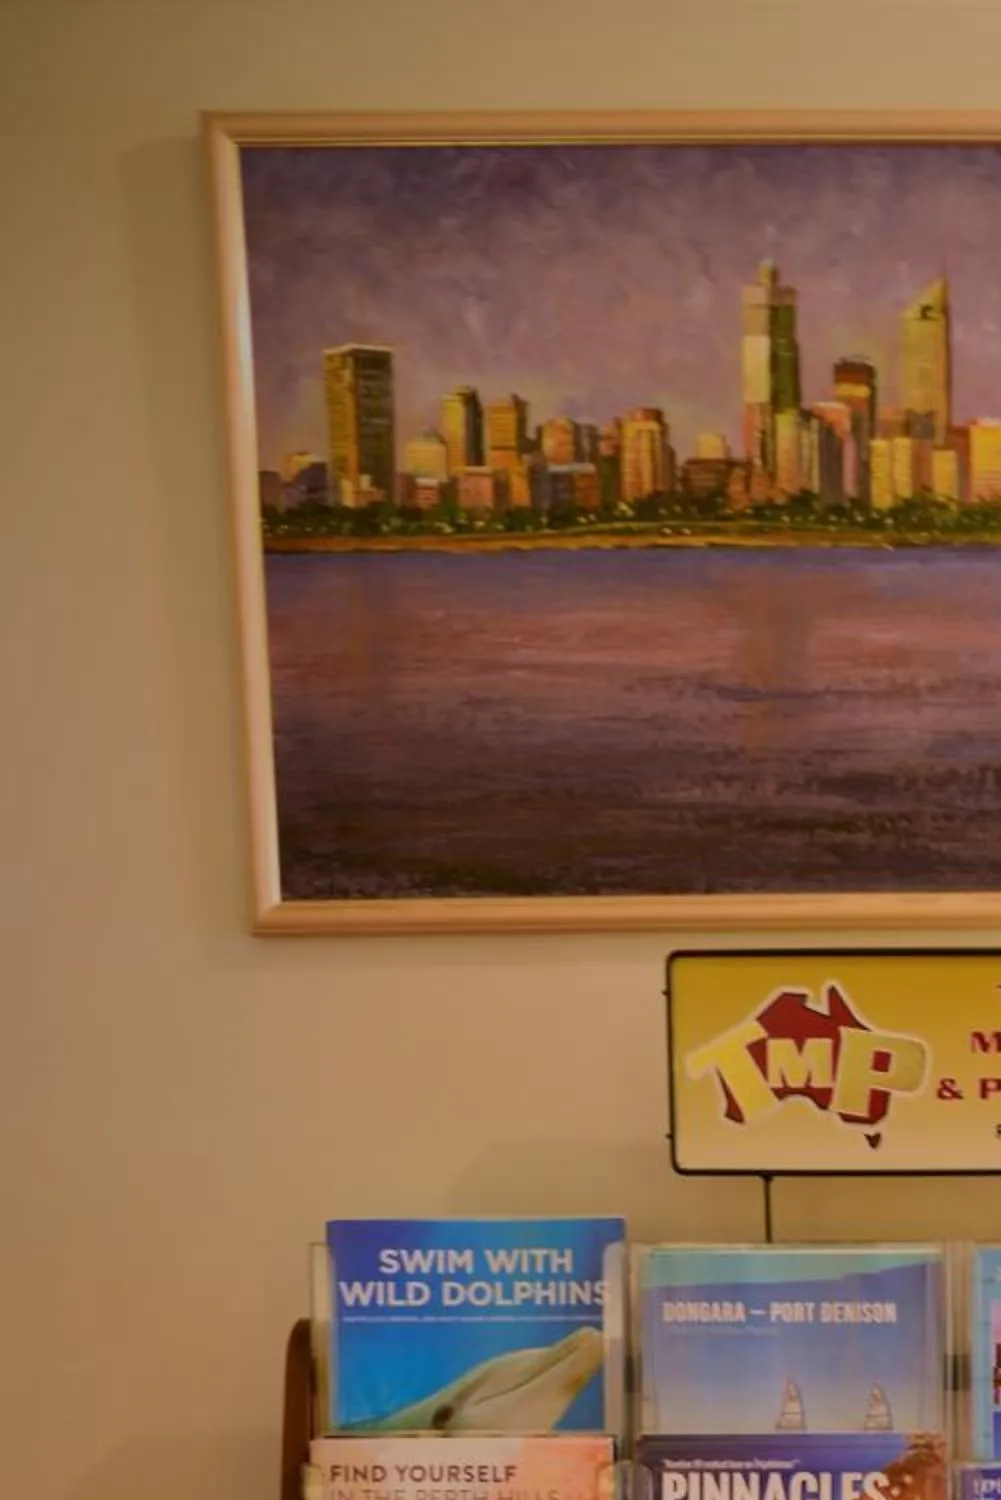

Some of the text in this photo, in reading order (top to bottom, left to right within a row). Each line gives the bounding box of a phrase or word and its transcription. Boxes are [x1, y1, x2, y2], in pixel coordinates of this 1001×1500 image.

[685, 1021, 930, 1124] TMP
[936, 1080, 965, 1101] &
[378, 1248, 573, 1274] SWIM WITH
[338, 1280, 612, 1307] WILD DOLPHINS
[662, 1301, 746, 1323] DONGARA
[770, 1302, 814, 1323] PORT
[820, 1302, 897, 1323] DENISON
[329, 1465, 518, 1483] FIND YOURSELF
